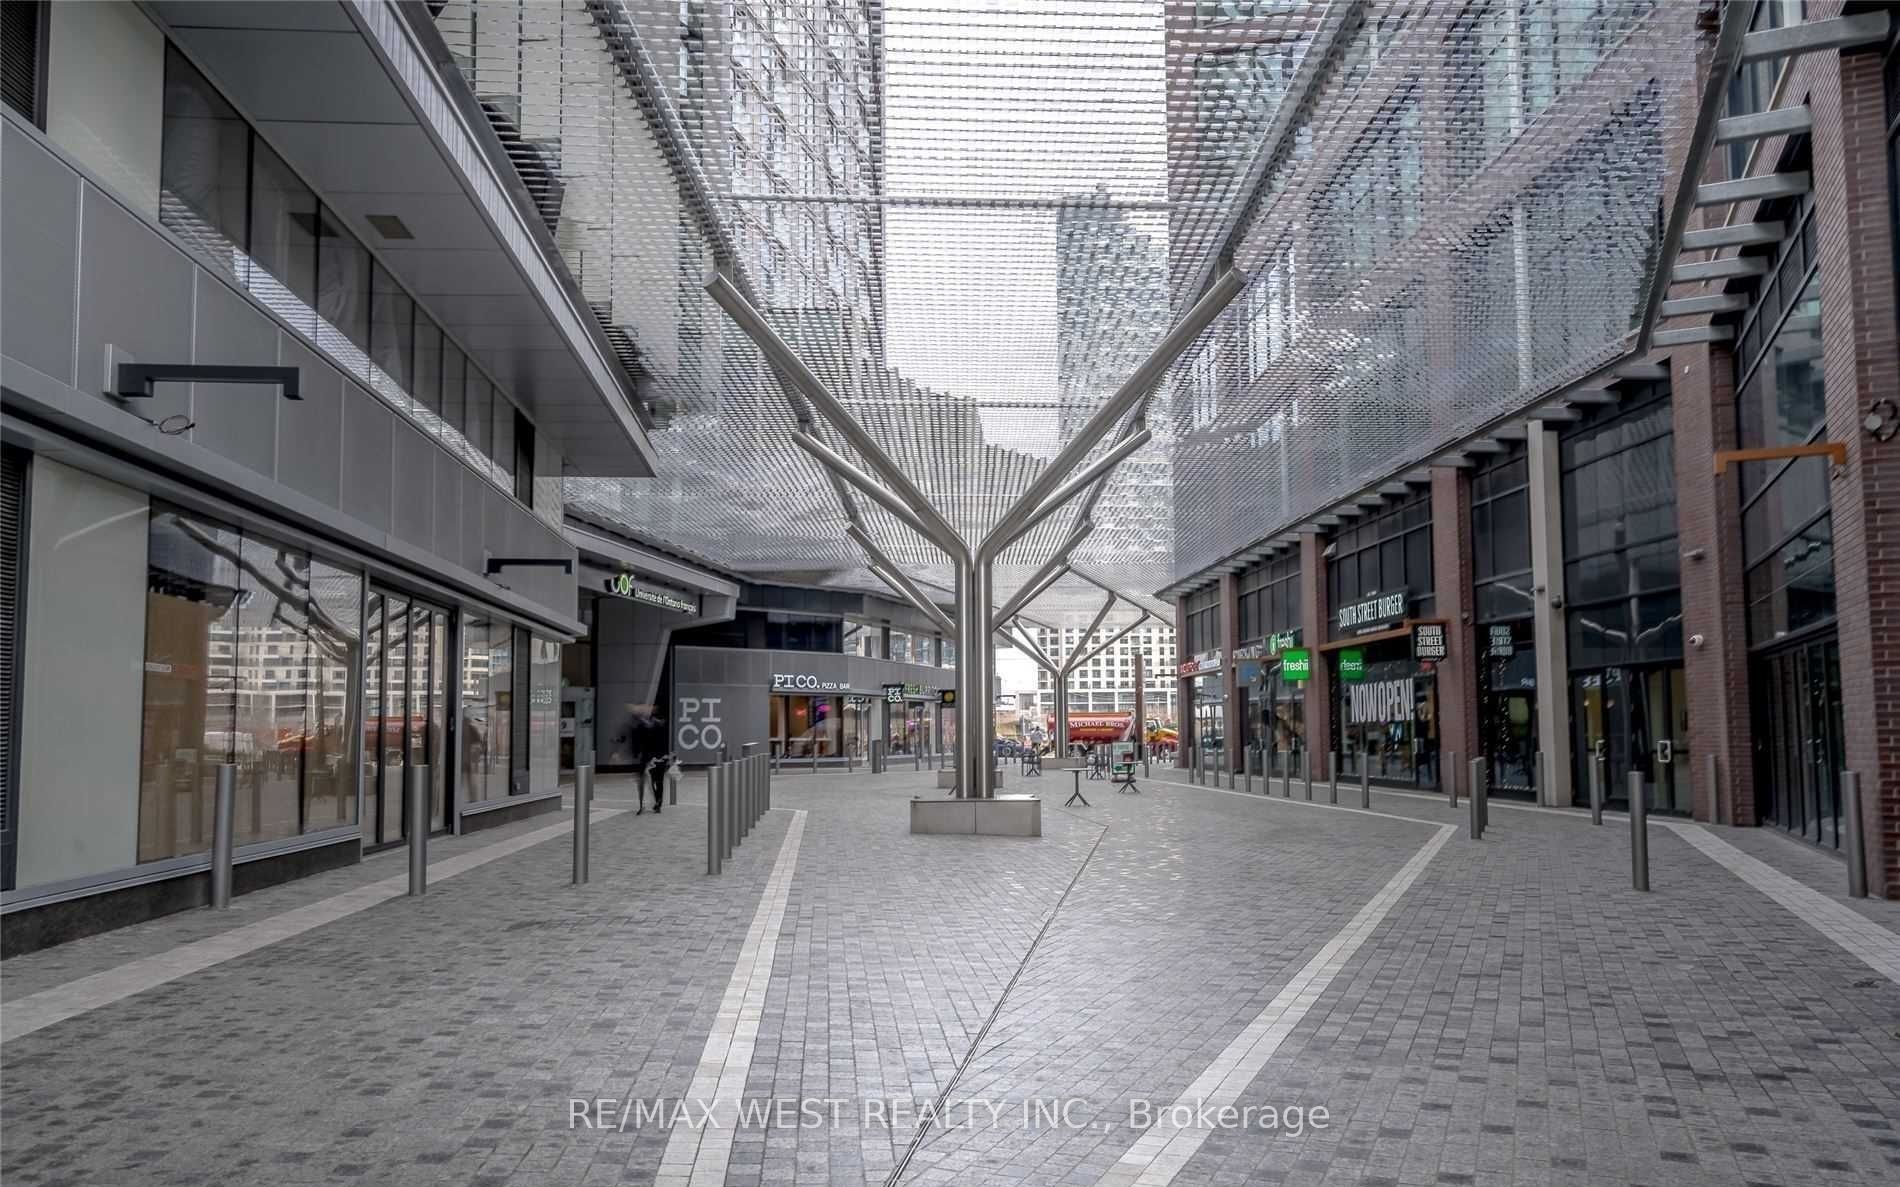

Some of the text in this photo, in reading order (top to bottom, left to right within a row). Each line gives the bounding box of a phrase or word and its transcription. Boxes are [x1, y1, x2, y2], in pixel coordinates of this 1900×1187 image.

[1339, 593, 1404, 627] SOUTH STREET BURGER
[1417, 624, 1442, 636] SOUTH
[1417, 636, 1443, 646] STREET
[1416, 646, 1446, 657] BURGER
[1283, 659, 1309, 672] freshii
[821, 681, 837, 690] PIZZA
[887, 688, 901, 696] PI
[1351, 678, 1414, 723] NOW OPEN!
[679, 697, 721, 722] PI
